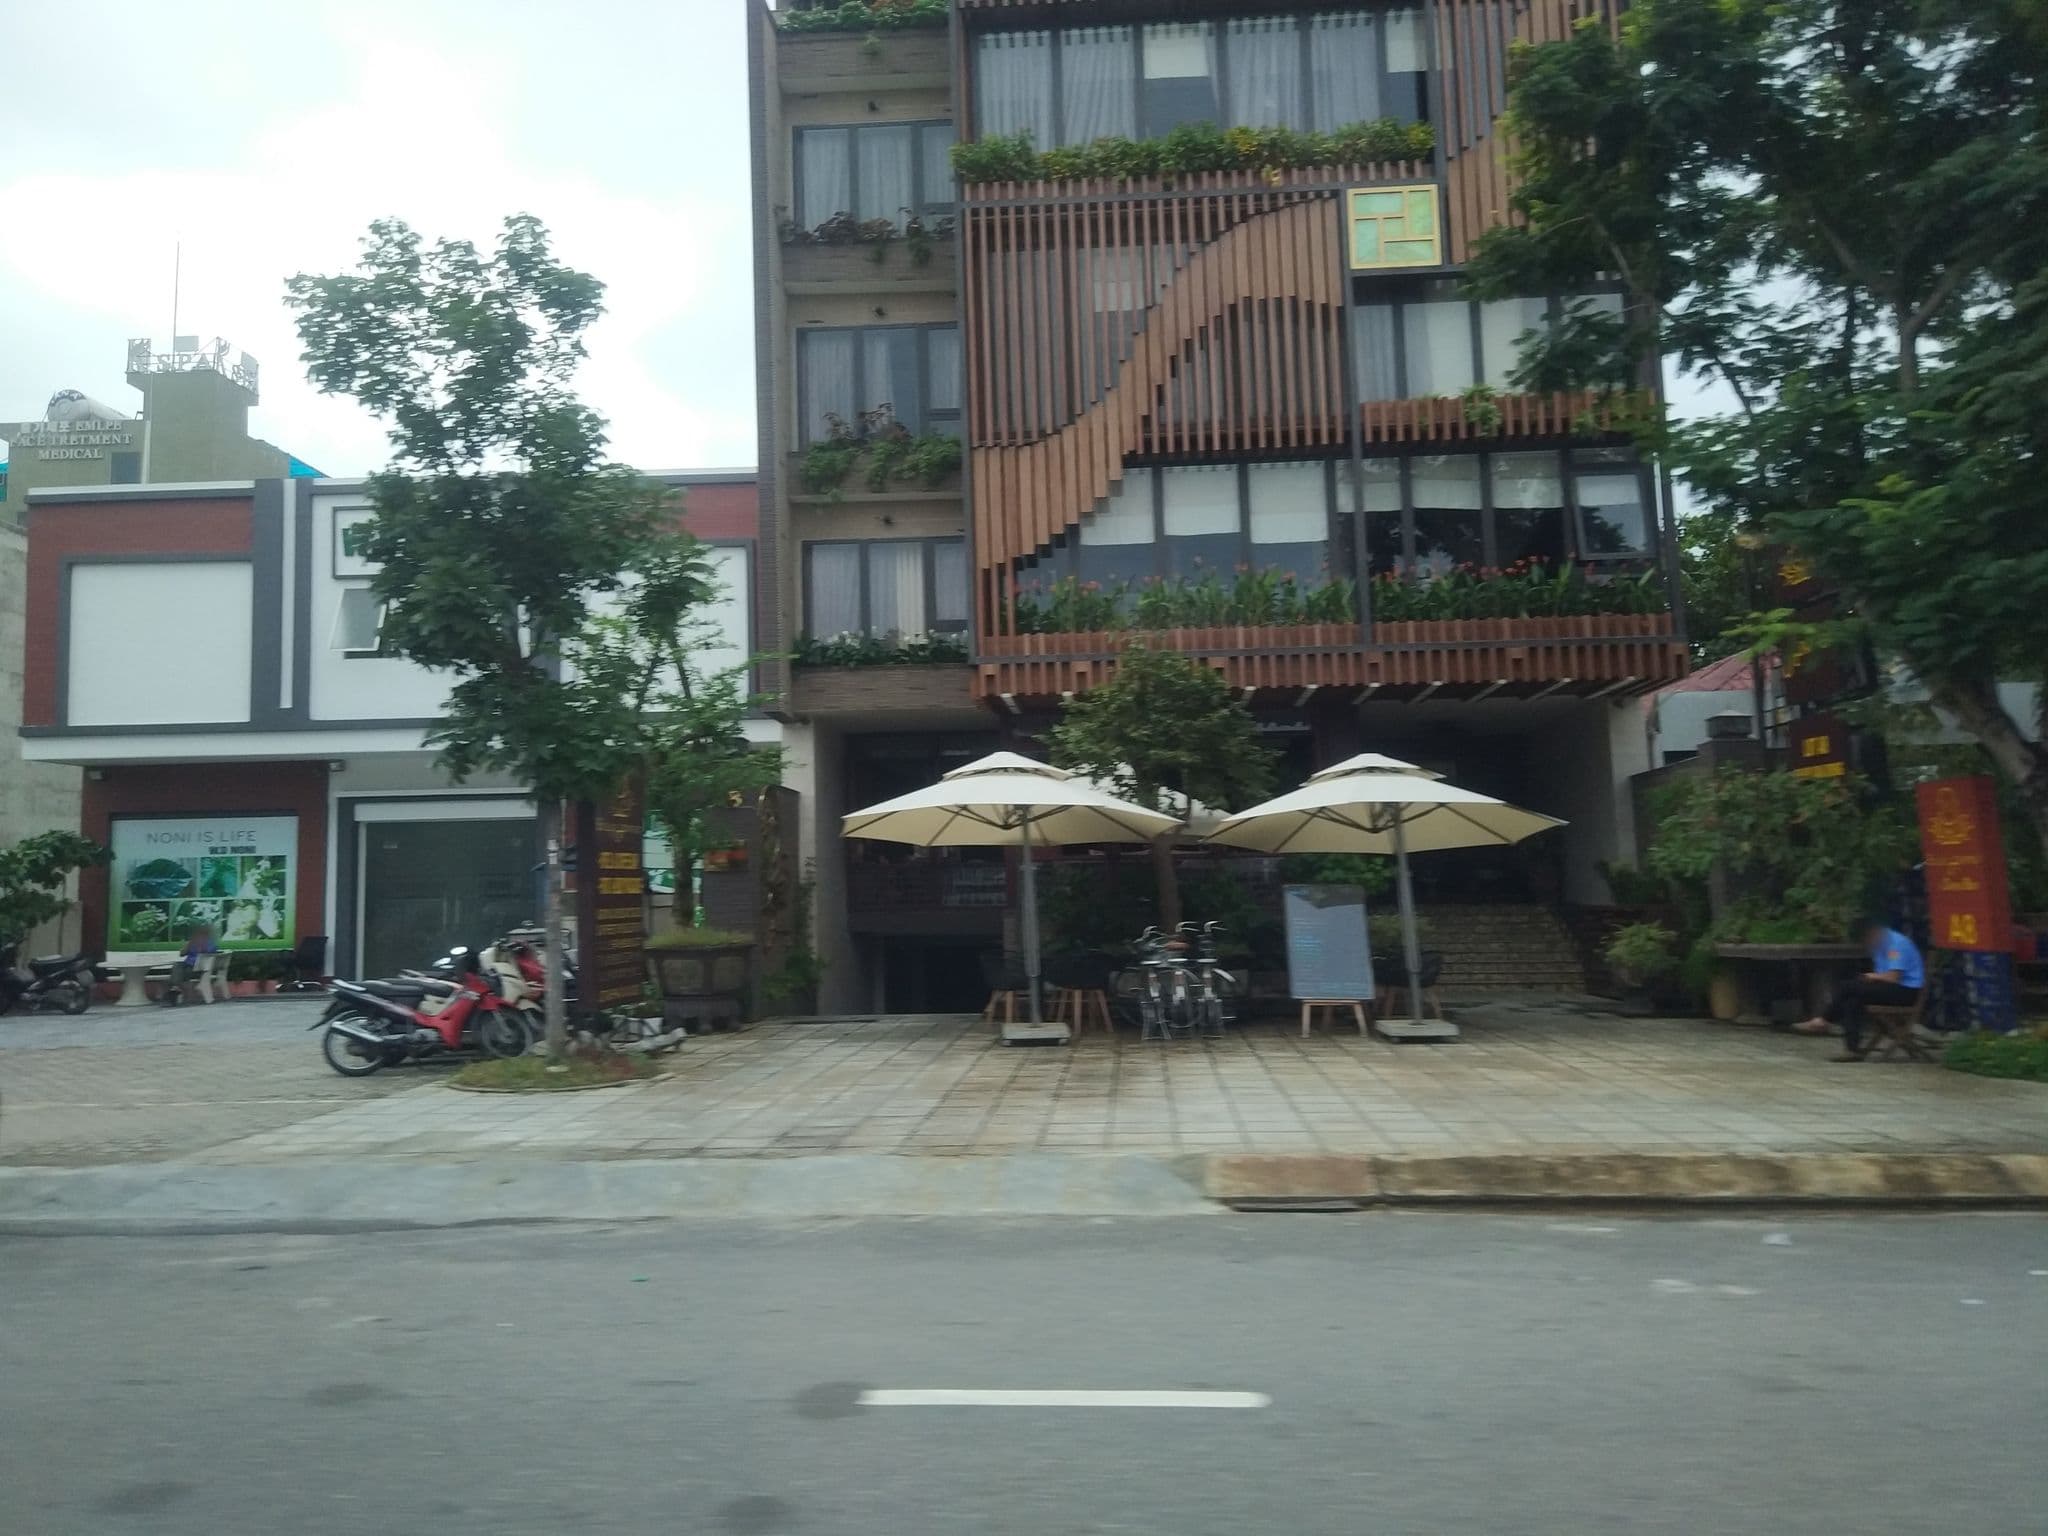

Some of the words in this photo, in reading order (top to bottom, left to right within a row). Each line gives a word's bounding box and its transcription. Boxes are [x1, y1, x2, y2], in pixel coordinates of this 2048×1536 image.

[39, 448, 103, 460] MEDICAL
[146, 832, 191, 844] NONI
[198, 831, 214, 843] IS
[220, 830, 257, 842] LIFE
